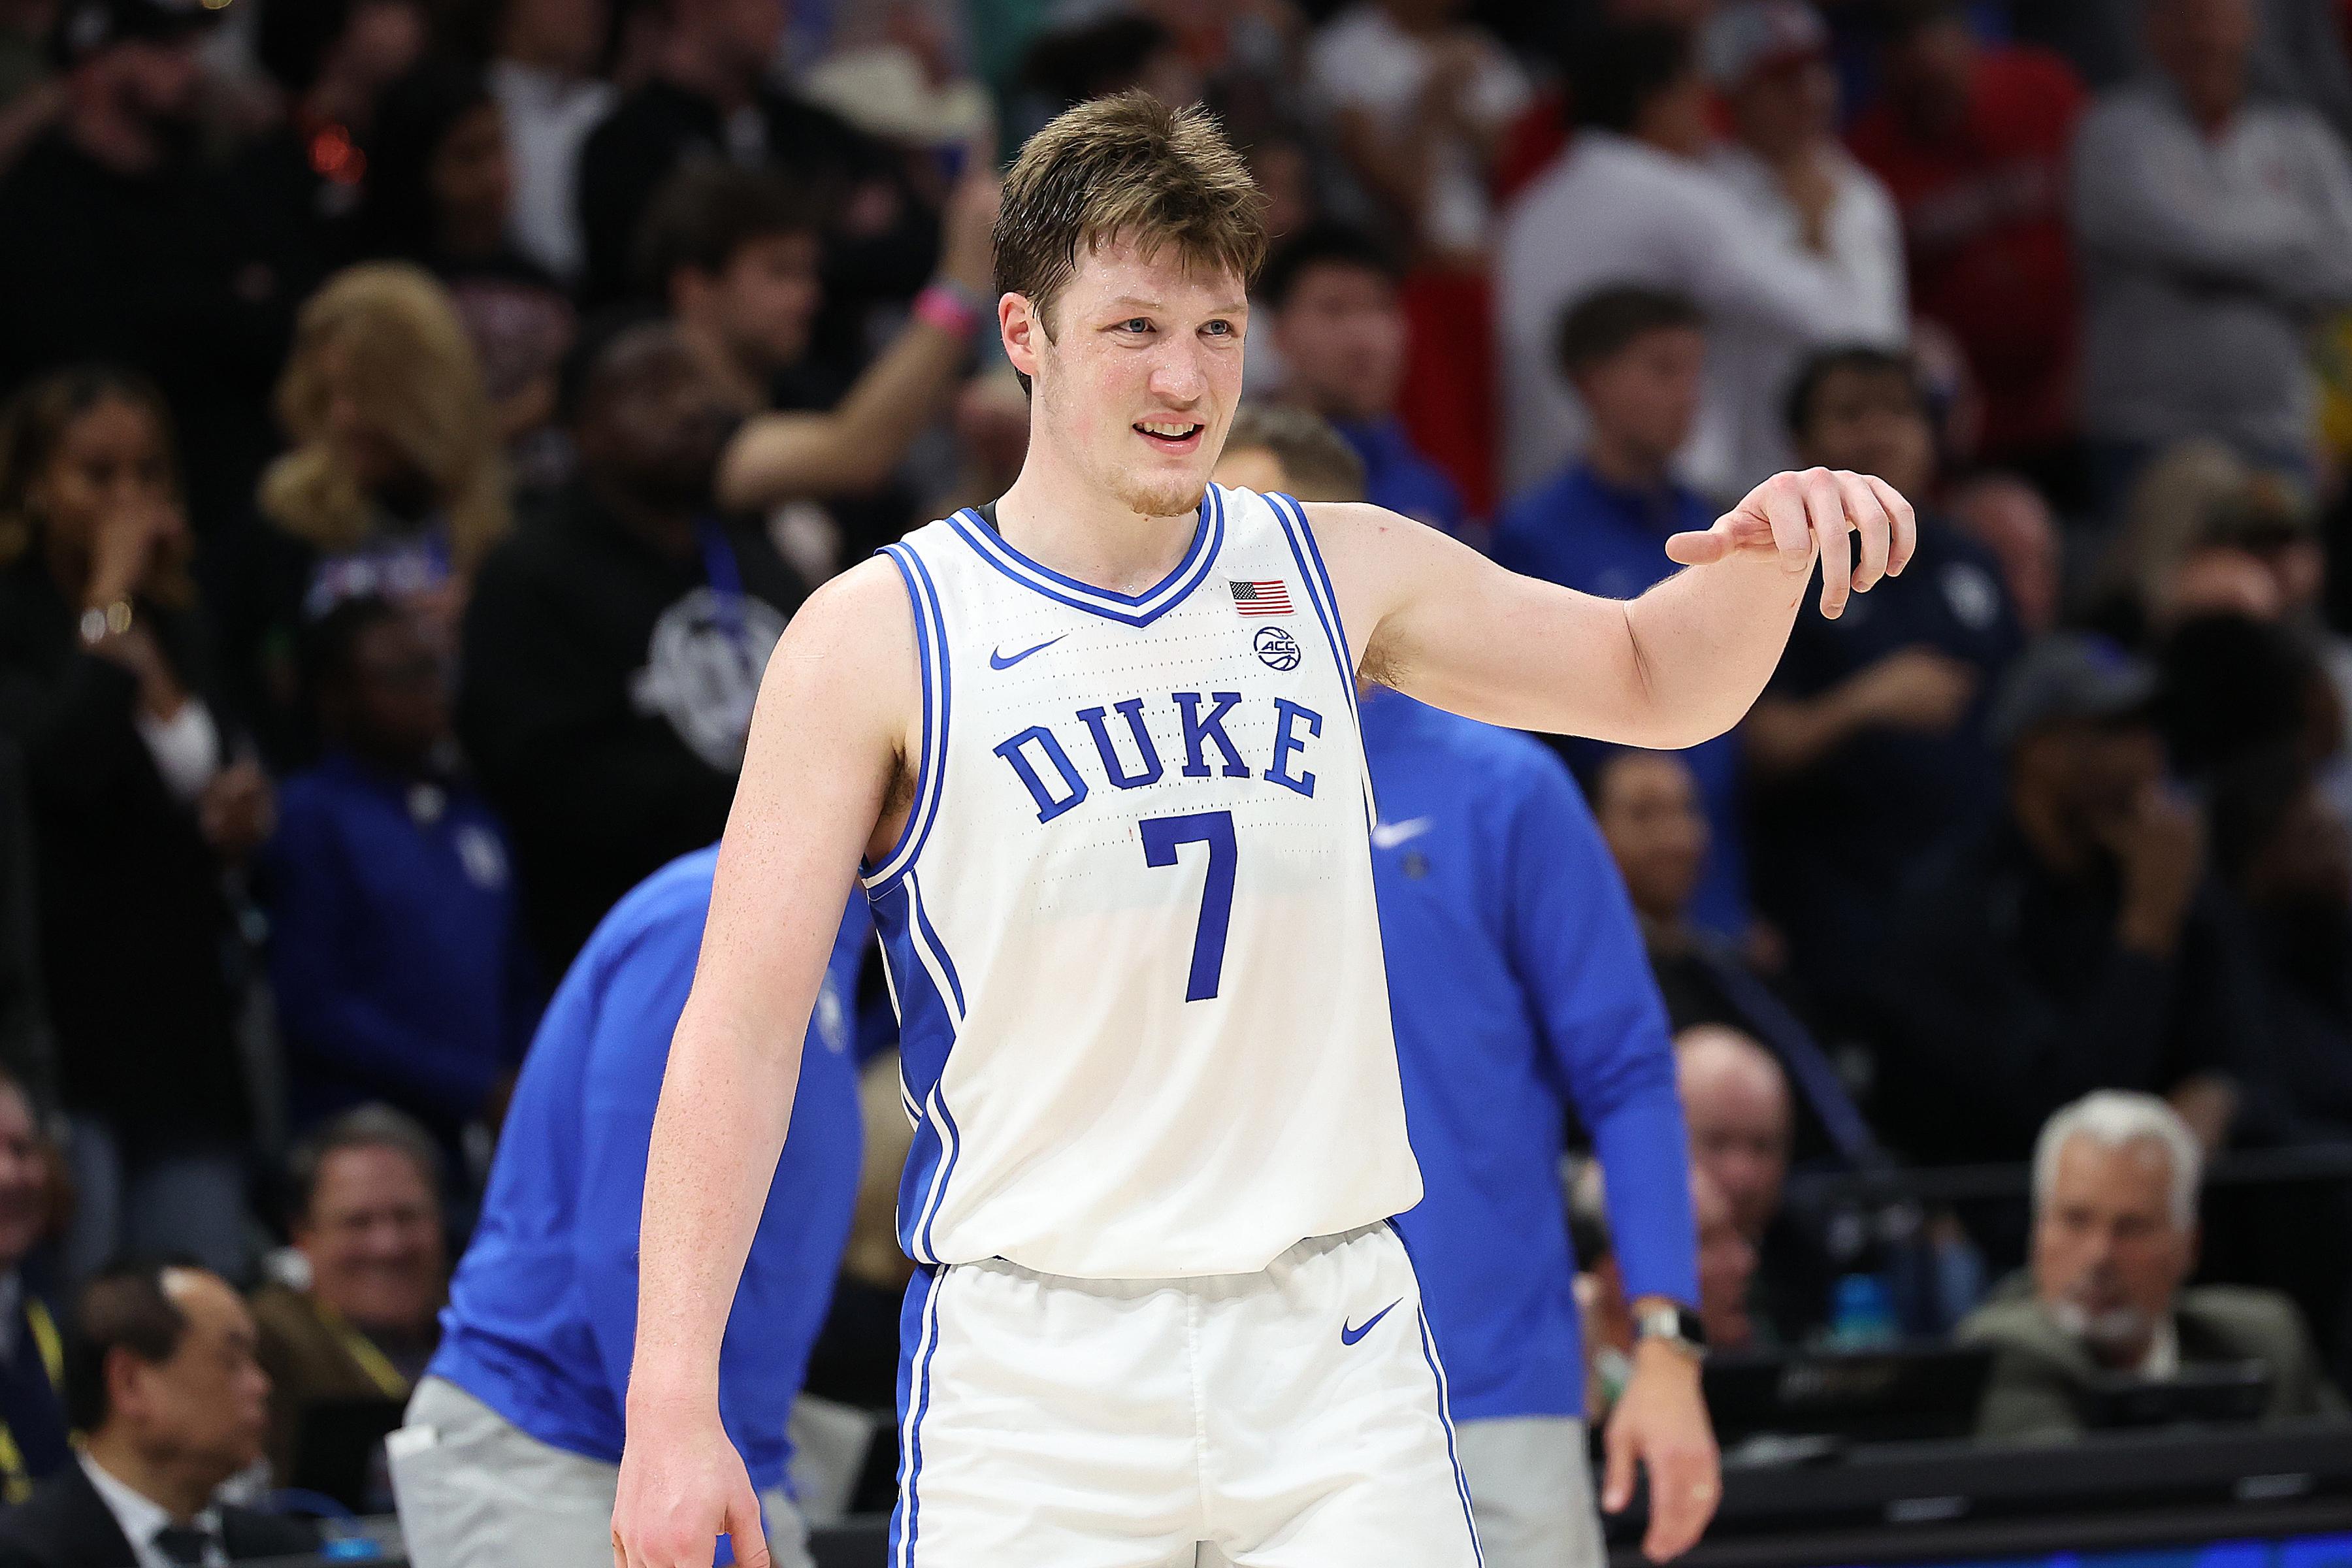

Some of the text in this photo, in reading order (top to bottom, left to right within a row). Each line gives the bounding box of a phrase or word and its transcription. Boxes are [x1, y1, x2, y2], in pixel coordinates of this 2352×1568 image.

[1261, 641, 1296, 651] ACC
[993, 692, 1323, 824] DUKE
[1139, 810, 1238, 1003] 7
